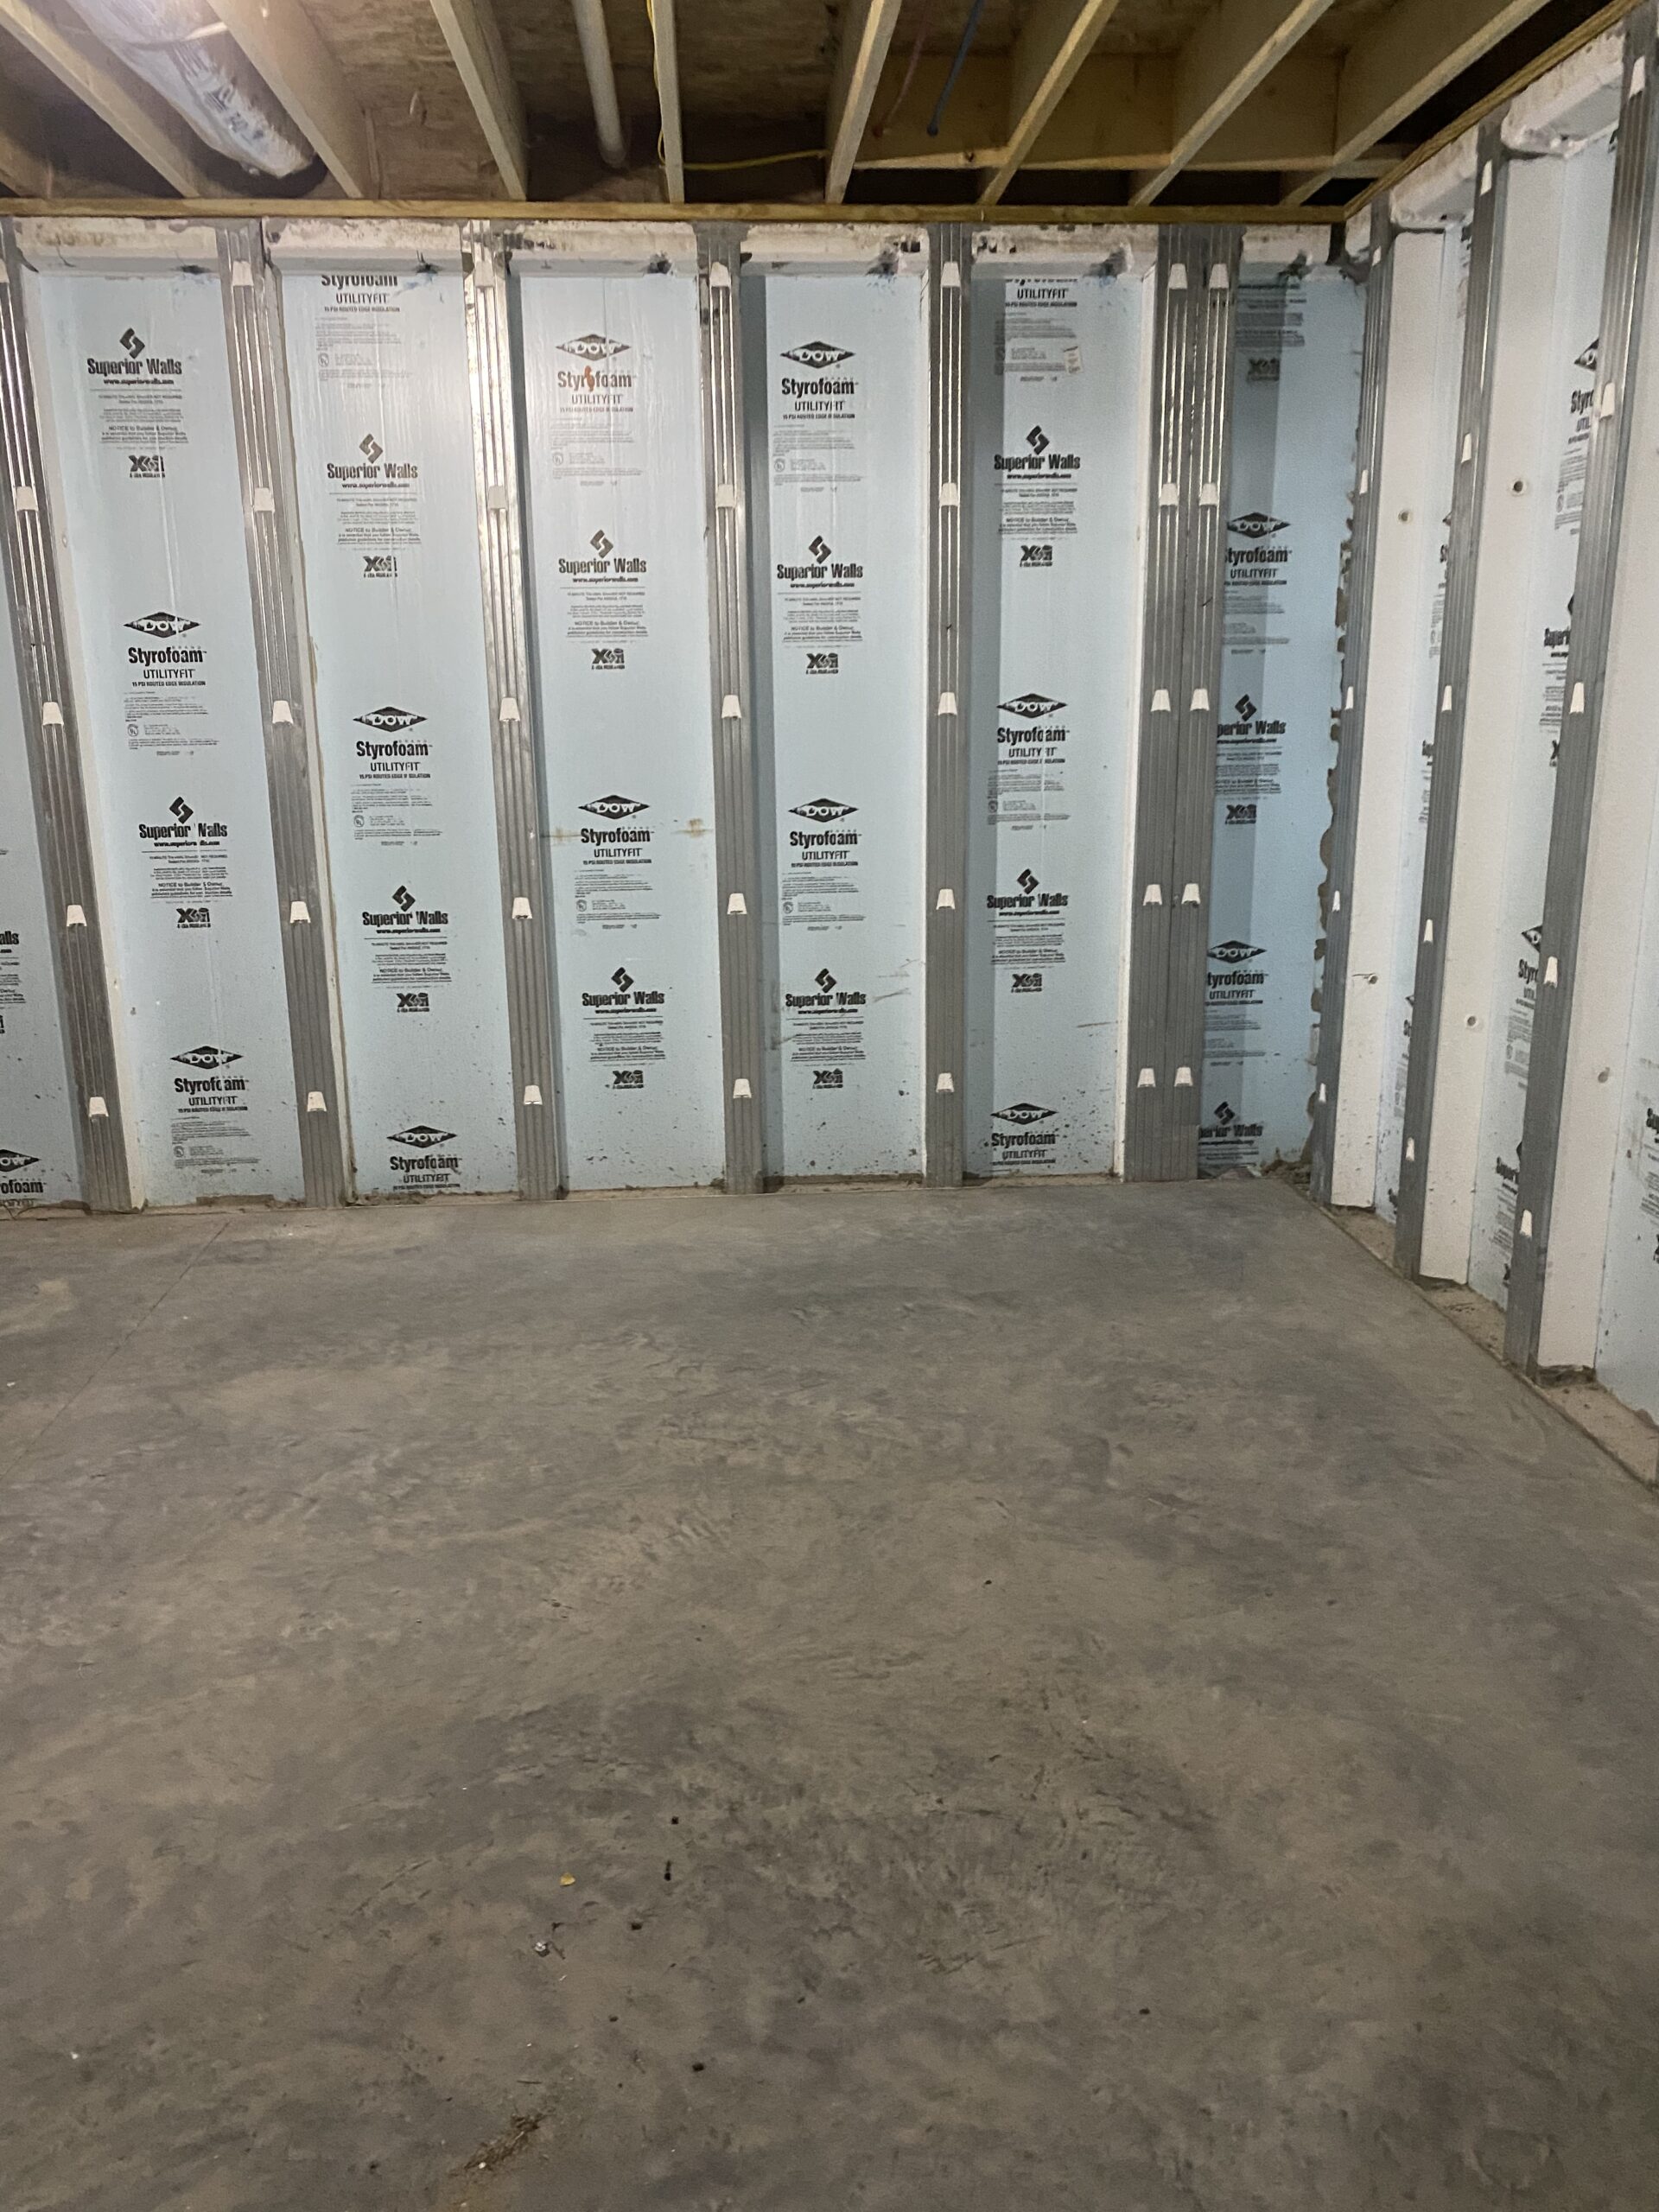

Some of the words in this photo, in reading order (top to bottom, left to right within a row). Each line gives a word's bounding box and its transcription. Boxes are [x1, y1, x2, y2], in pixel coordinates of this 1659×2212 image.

[335, 293, 388, 304] UTILITYFIT
[1017, 288, 1067, 299] UTILITYFIT
[86, 358, 143, 377] Superior
[146, 358, 182, 375] Walls
[781, 378, 855, 398] Styrofoam
[795, 401, 844, 411] UTILITYFIT
[327, 462, 380, 480] Superior
[384, 462, 418, 479] Walls
[994, 454, 1046, 472] Superior
[1048, 454, 1081, 470] Walls
[558, 558, 610, 575] Superior
[613, 558, 646, 573] Walls
[777, 563, 828, 581] Superior
[831, 563, 863, 578] Walls
[1230, 569, 1278, 579] UTILITYFIT
[128, 647, 204, 666] Styrofoam
[143, 669, 194, 679] UTILITYFIT
[997, 727, 1066, 746] Styrofoam
[1217, 721, 1252, 738] perior
[1255, 720, 1287, 734] Walls
[356, 741, 429, 760] Styrofoam
[1008, 747, 1057, 757] UTILITYIT
[370, 761, 421, 772] UTILITYFIT
[138, 823, 191, 840] Superior
[194, 823, 228, 837] Walls
[581, 828, 651, 846] Styrofoam
[790, 830, 858, 849] Styrofoam
[594, 848, 642, 858] UTILITYFIT
[802, 850, 850, 861] UTILITYFIT
[987, 893, 1035, 910] Superior
[1038, 893, 1069, 907] Walls
[362, 911, 413, 927] Superior
[416, 911, 448, 925] Walls
[0, 930, 20, 945] alls
[1207, 970, 1264, 988] tyrofoam
[582, 992, 631, 1007] Superior
[633, 990, 664, 1005] Walls
[785, 993, 834, 1008] Superior
[836, 991, 867, 1005] Walls
[1209, 989, 1255, 1000] UTILITYFIT
[174, 1077, 246, 1095] Styrofoam
[991, 1132, 1056, 1148] Styrofoam
[1002, 1149, 1047, 1160] UTILITYFIT
[390, 1155, 459, 1173] Styrofoam
[0, 1179, 44, 1194] ofoam
[403, 1173, 450, 1183] UTILITYFIT
